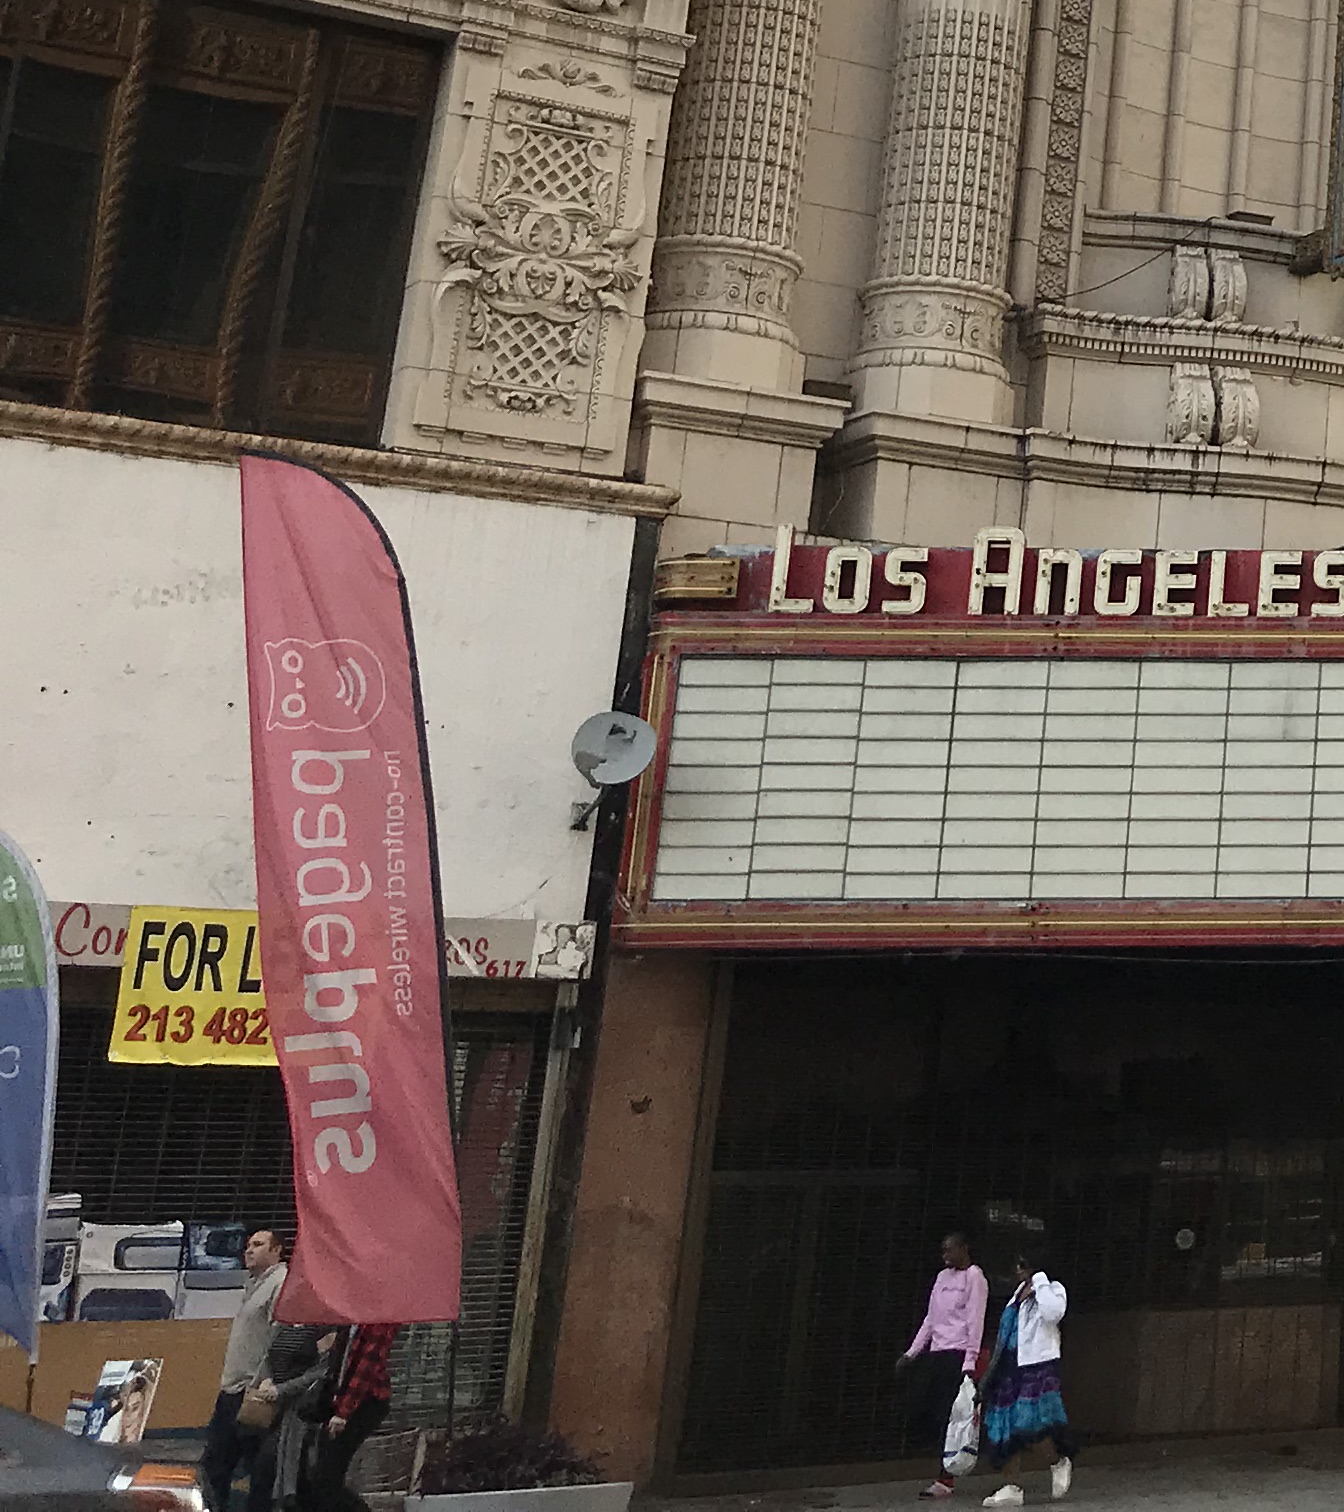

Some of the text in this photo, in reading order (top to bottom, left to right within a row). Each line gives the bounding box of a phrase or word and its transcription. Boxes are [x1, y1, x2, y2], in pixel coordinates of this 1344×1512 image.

[132, 921, 228, 993] FOR
[484, 959, 527, 979] 617
[123, 1005, 195, 1043] 213
